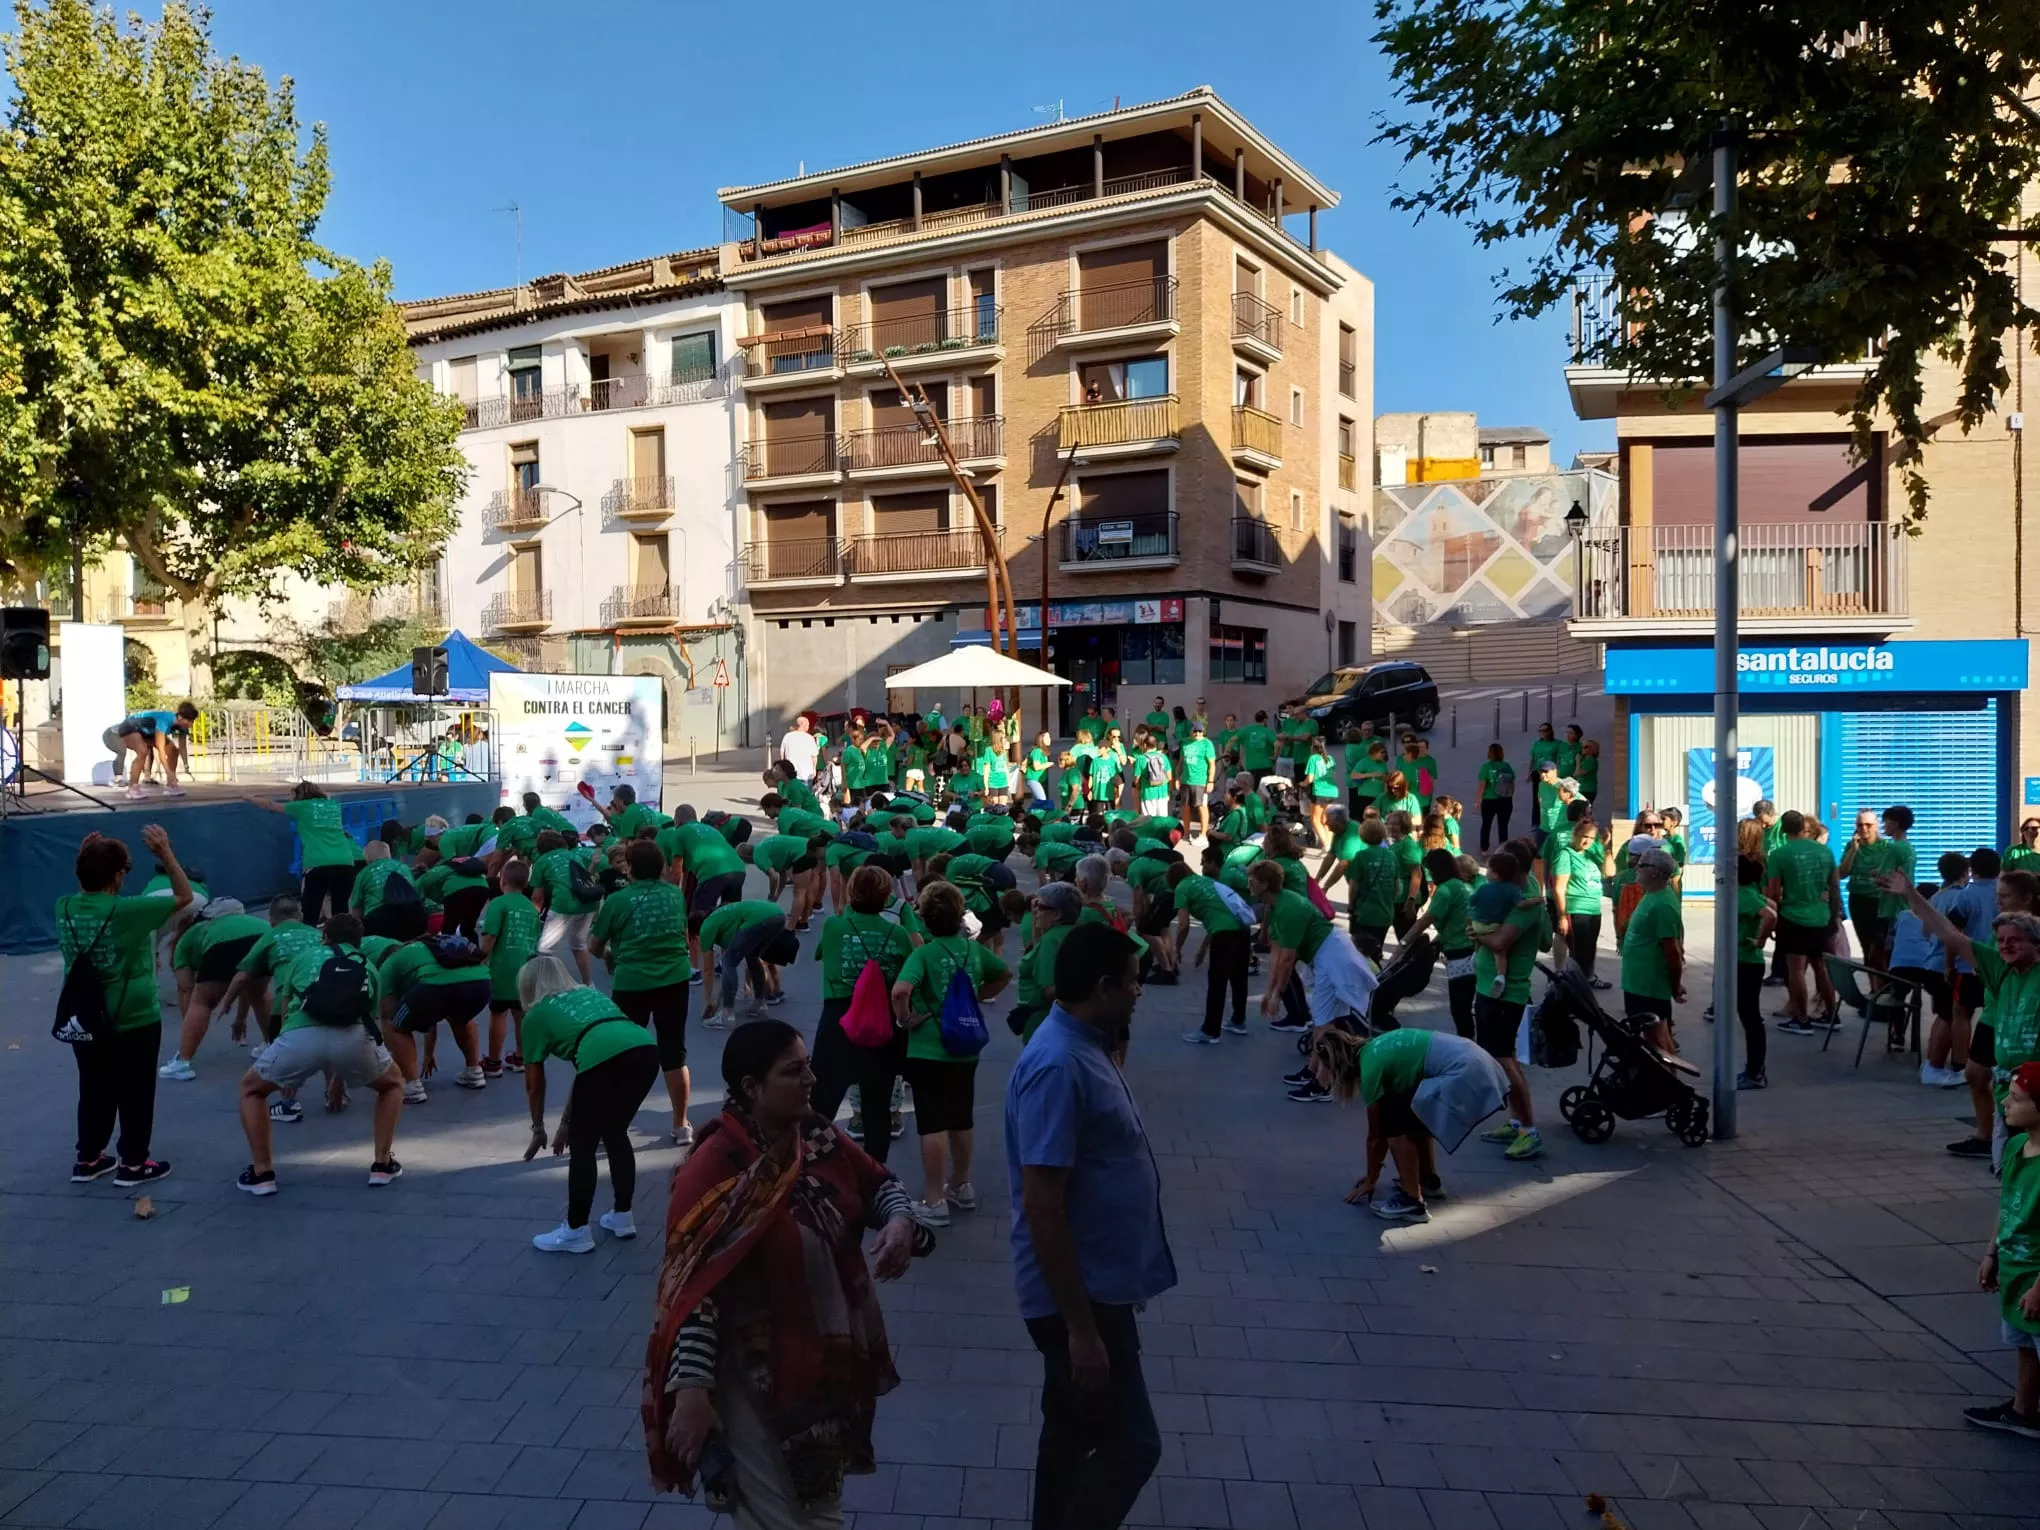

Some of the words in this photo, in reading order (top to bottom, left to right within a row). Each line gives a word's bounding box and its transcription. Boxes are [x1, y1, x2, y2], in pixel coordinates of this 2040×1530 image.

[1736, 646, 1894, 672] santalucía
[1789, 673, 1838, 684] SEGUROS
[547, 679, 551, 695] I
[555, 679, 610, 696] MARCHA
[523, 700, 569, 715] CONTRA
[573, 700, 585, 715] EL
[589, 698, 632, 715] CÁNCER
[56, 1031, 93, 1041] adidas
